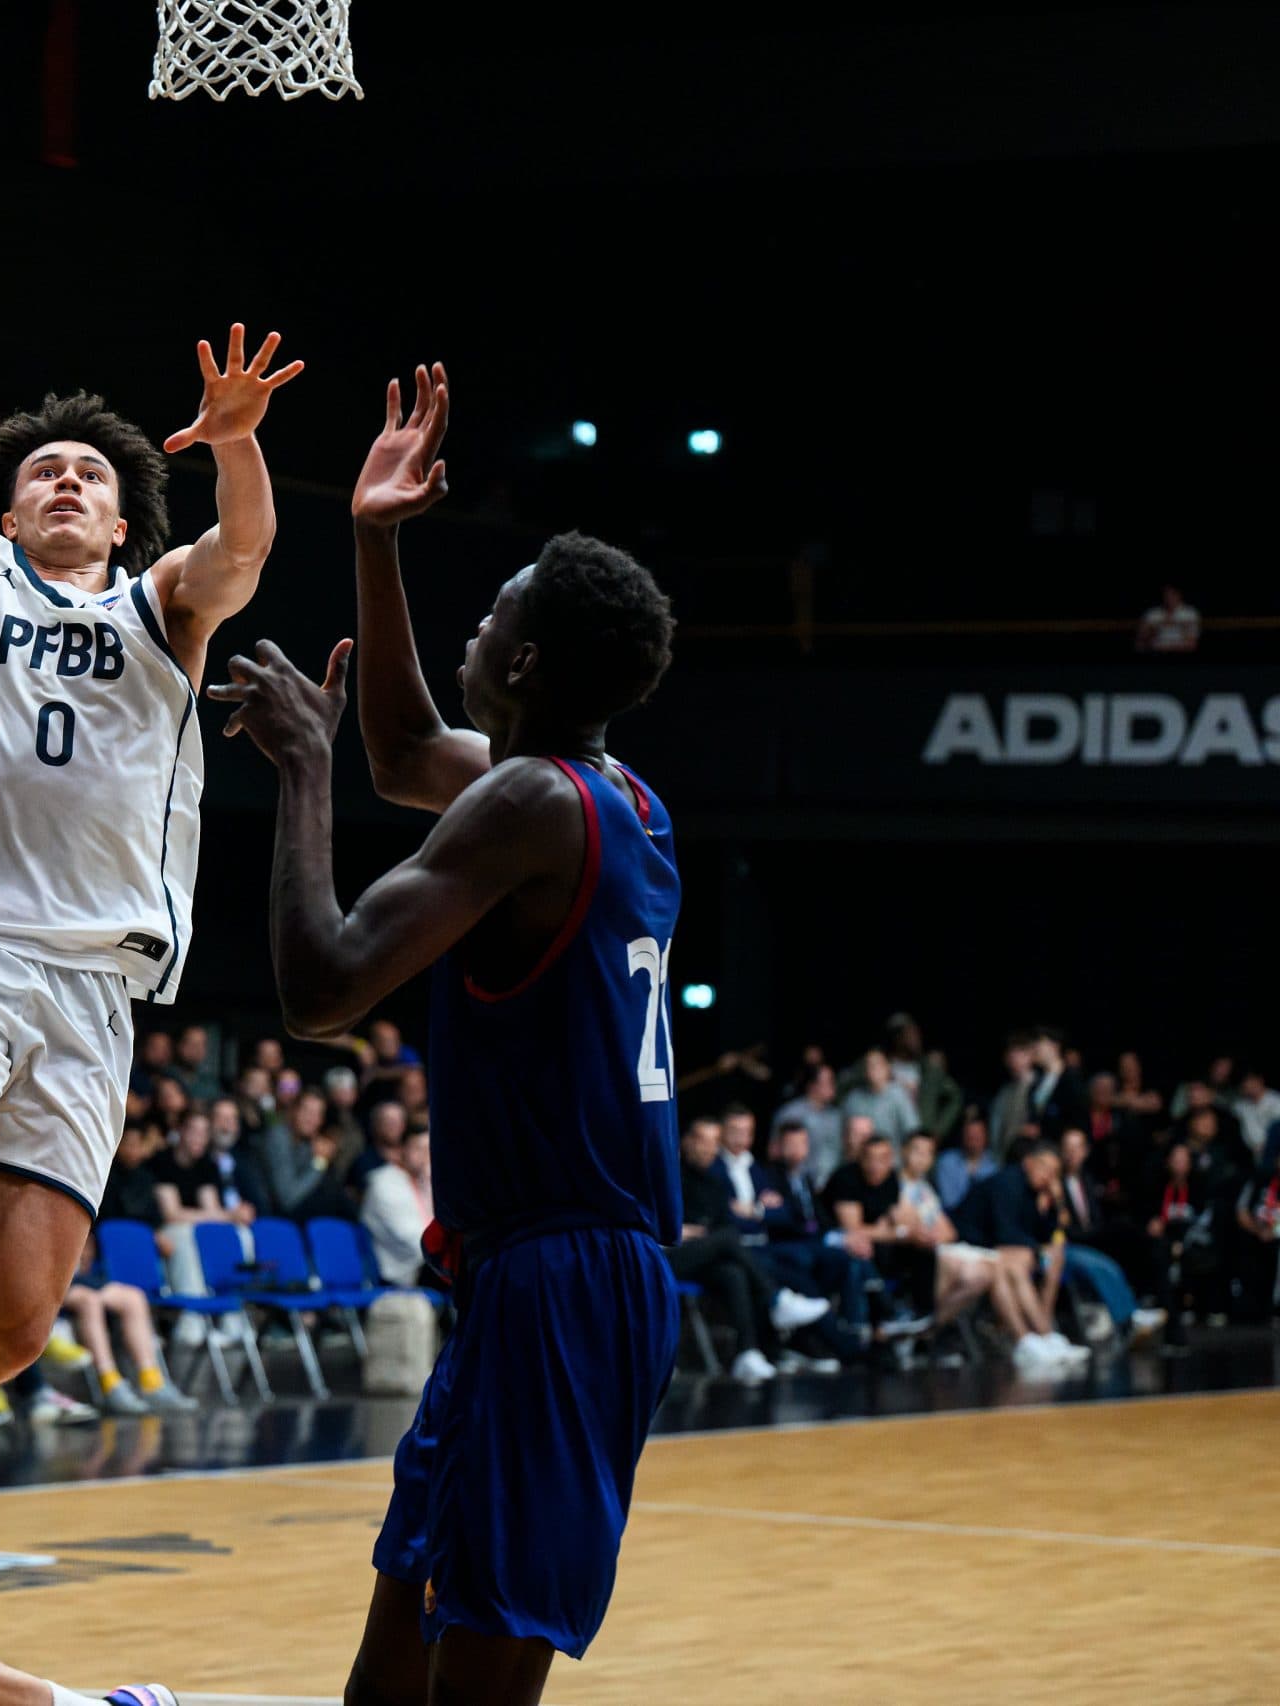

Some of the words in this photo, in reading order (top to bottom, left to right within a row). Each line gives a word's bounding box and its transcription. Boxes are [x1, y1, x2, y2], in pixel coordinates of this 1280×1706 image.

[36, 701, 75, 767] 0
[922, 694, 1280, 766] ADIDA
[627, 936, 674, 1102] 2
